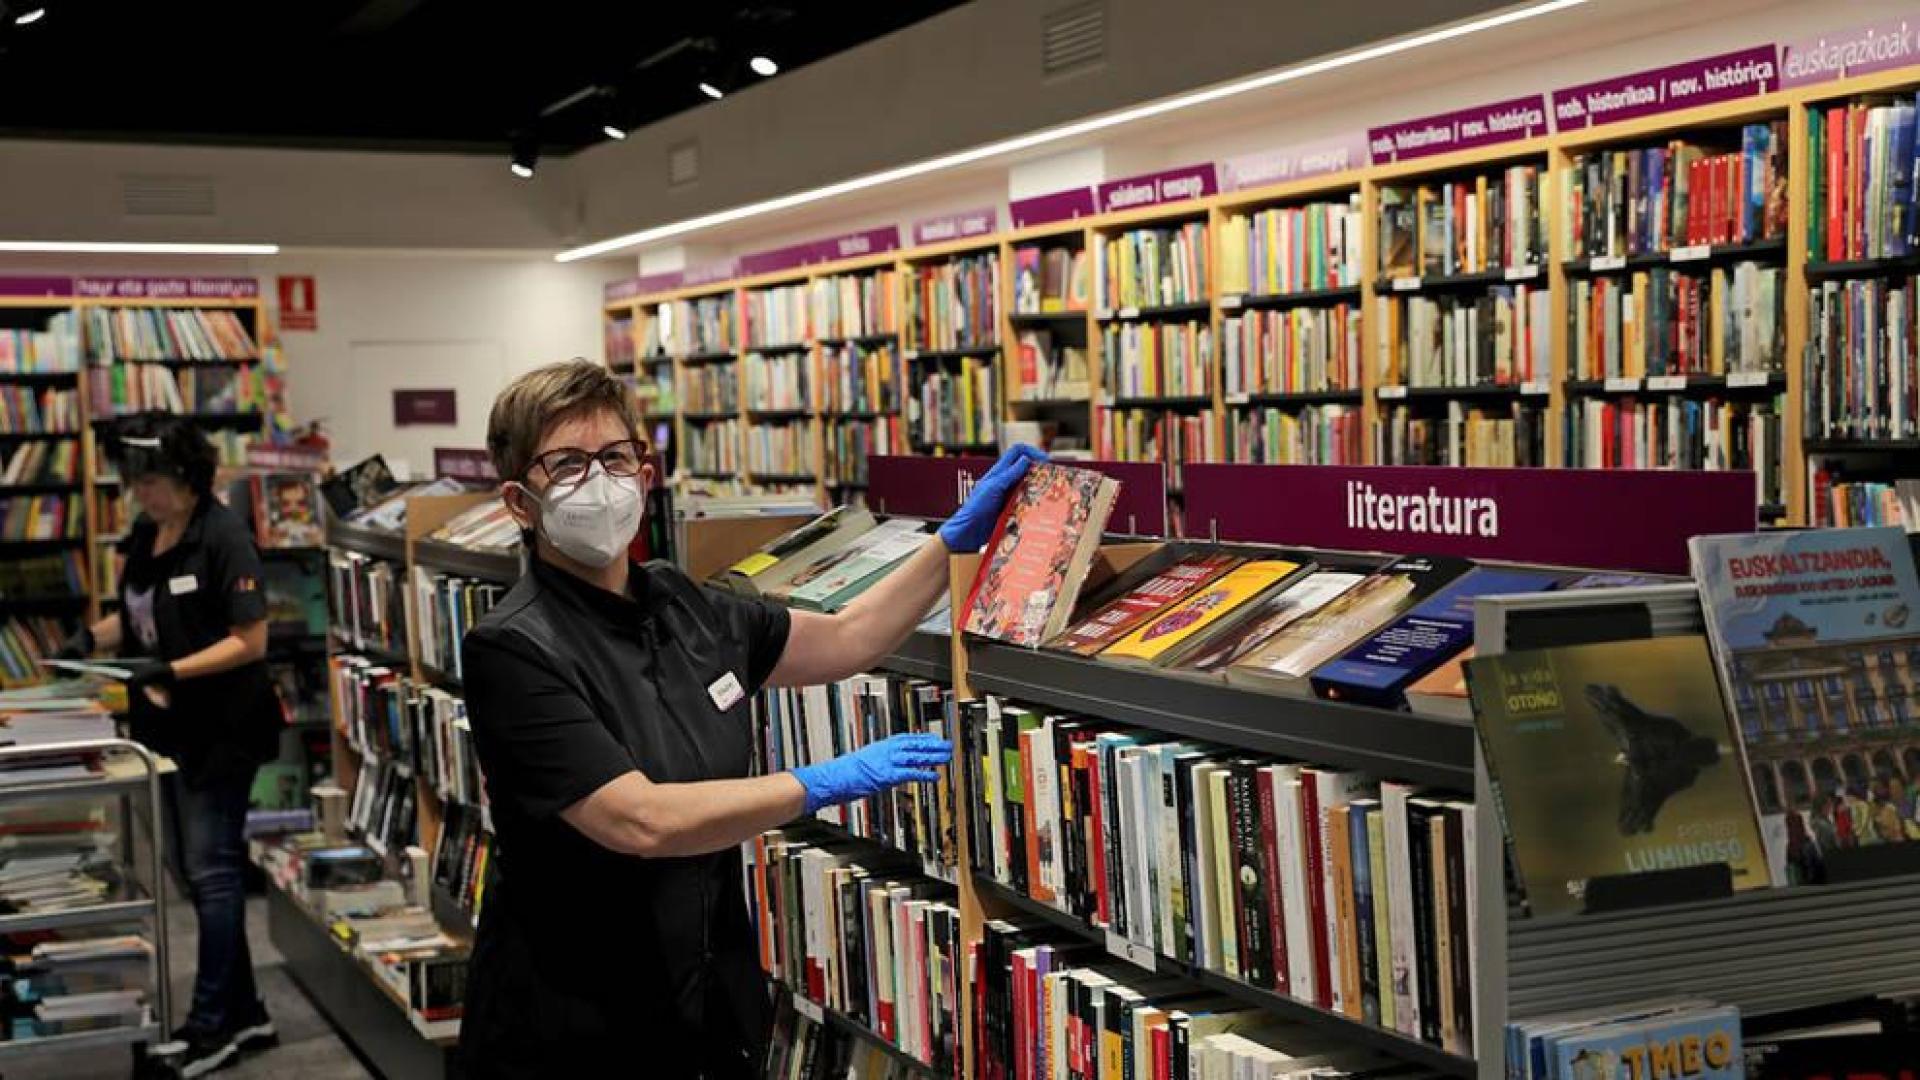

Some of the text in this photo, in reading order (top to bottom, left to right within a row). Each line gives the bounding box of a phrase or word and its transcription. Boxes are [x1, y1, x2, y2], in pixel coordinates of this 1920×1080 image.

[1785, 21, 1911, 78] euskarazkoak
[1557, 98, 1587, 119] nob.
[1586, 85, 1656, 114] historikoa
[1670, 77, 1703, 97] nov.
[1704, 59, 1775, 90] histórica
[1347, 480, 1498, 537] literatura
[1625, 839, 1745, 873] LUMINOSO
[1620, 1031, 1732, 1080] TMEO
